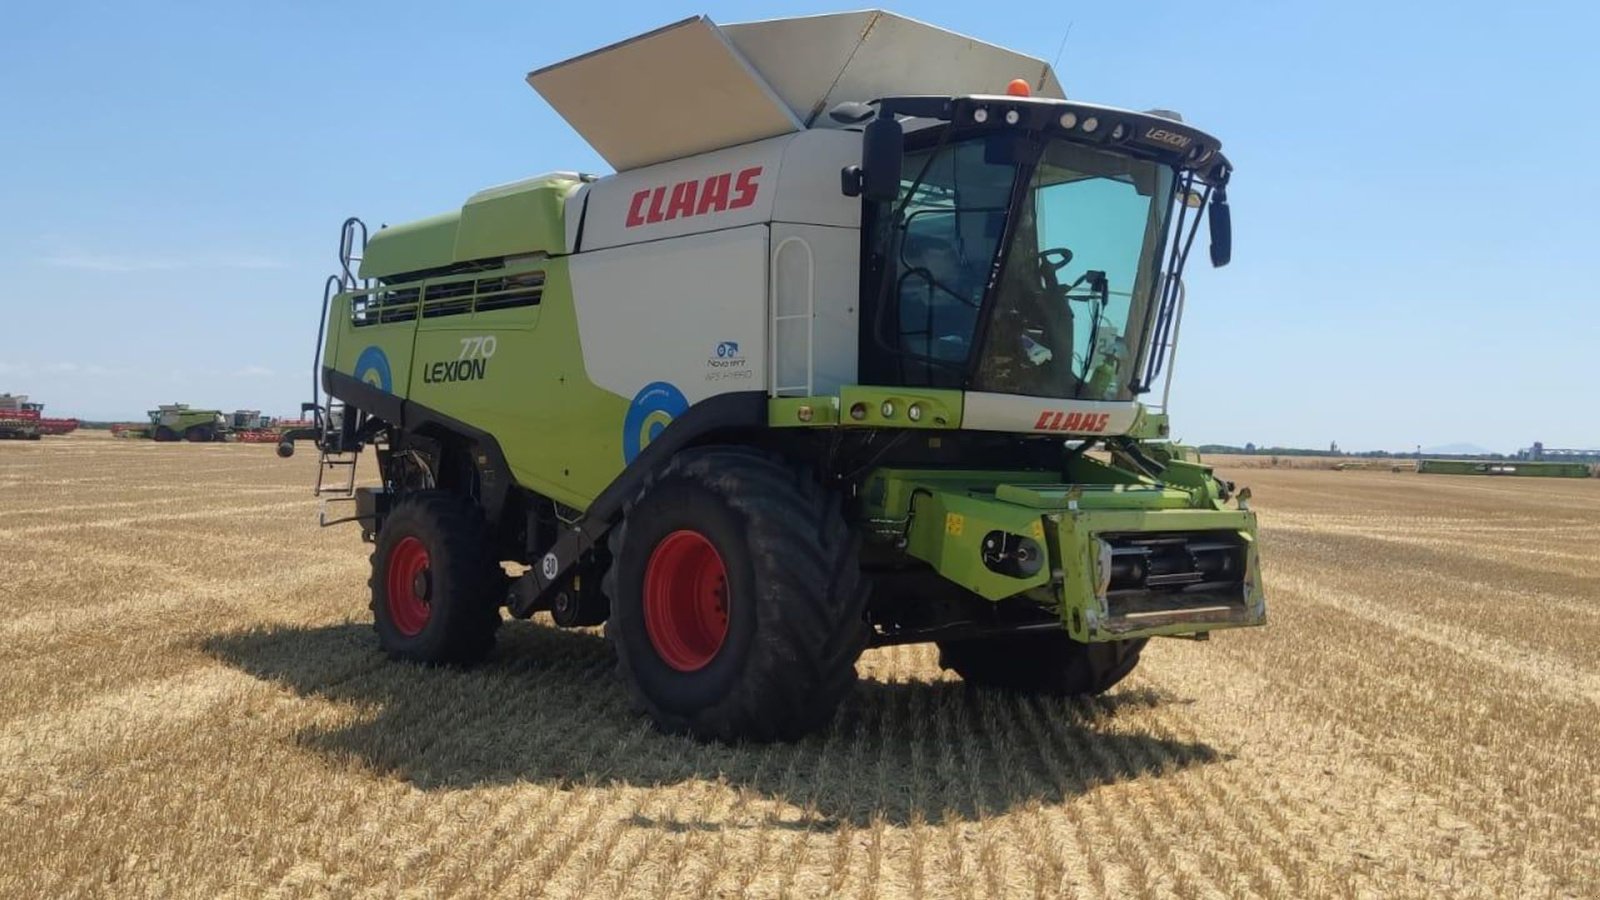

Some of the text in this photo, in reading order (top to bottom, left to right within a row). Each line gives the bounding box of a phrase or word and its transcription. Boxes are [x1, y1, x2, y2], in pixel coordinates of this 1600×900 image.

[1145, 126, 1192, 148] LEXION
[625, 166, 763, 228] CLAAS
[459, 335, 497, 359] 770
[423, 358, 487, 384] LEXION
[1034, 410, 1110, 433] CLAAS
[546, 556, 557, 575] 30
